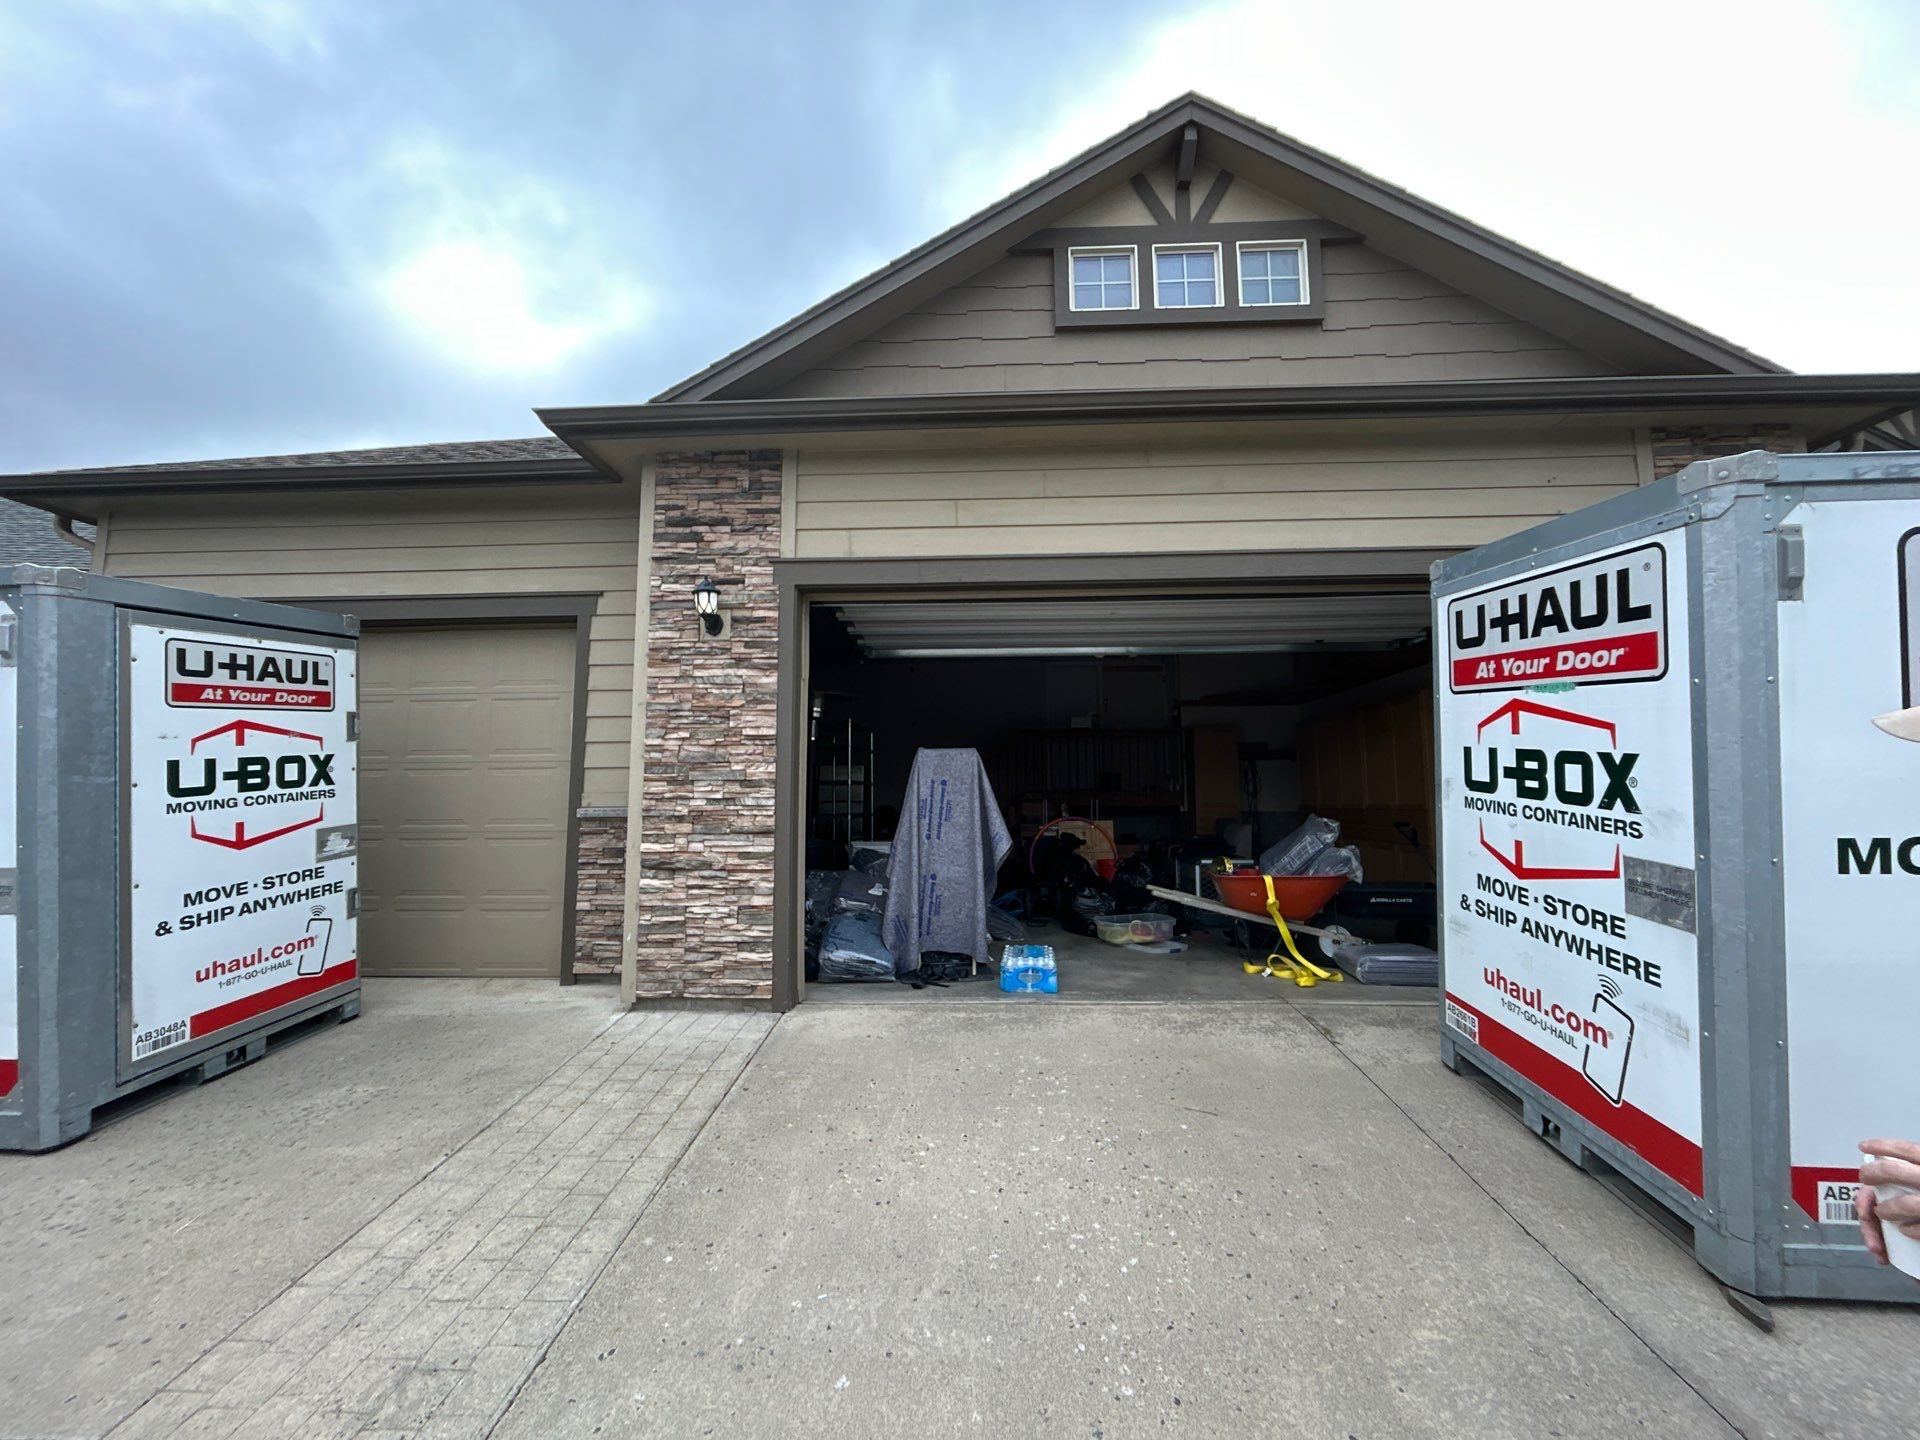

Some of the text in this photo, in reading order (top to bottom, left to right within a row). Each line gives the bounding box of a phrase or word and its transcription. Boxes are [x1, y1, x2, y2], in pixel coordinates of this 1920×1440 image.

[1455, 567, 1652, 649] U-HAUL
[176, 647, 329, 686] U-HAUL
[1475, 647, 1625, 679] At Your Door
[200, 688, 316, 704] At Your Door
[166, 753, 336, 798] U-BOX
[1463, 746, 1643, 814] U-BOX
[166, 788, 336, 815] MOVING CONTAINERS
[1464, 795, 1644, 840] MOVING CONTAINERS
[154, 880, 344, 937] & SHIP ANYWHERE
[183, 866, 325, 908] MOVE STORE
[1476, 873, 1627, 940] MOVE STORE
[195, 935, 316, 983] uhaul.com
[1460, 893, 1662, 989] & SHIP ANYWHERE
[218, 958, 294, 989] 1-877-GO-U-HAUL
[1483, 966, 1609, 1049] uhaul.com
[1501, 997, 1579, 1049] 1-877-GO-U-HAUL
[135, 1019, 187, 1046] AB3048A
